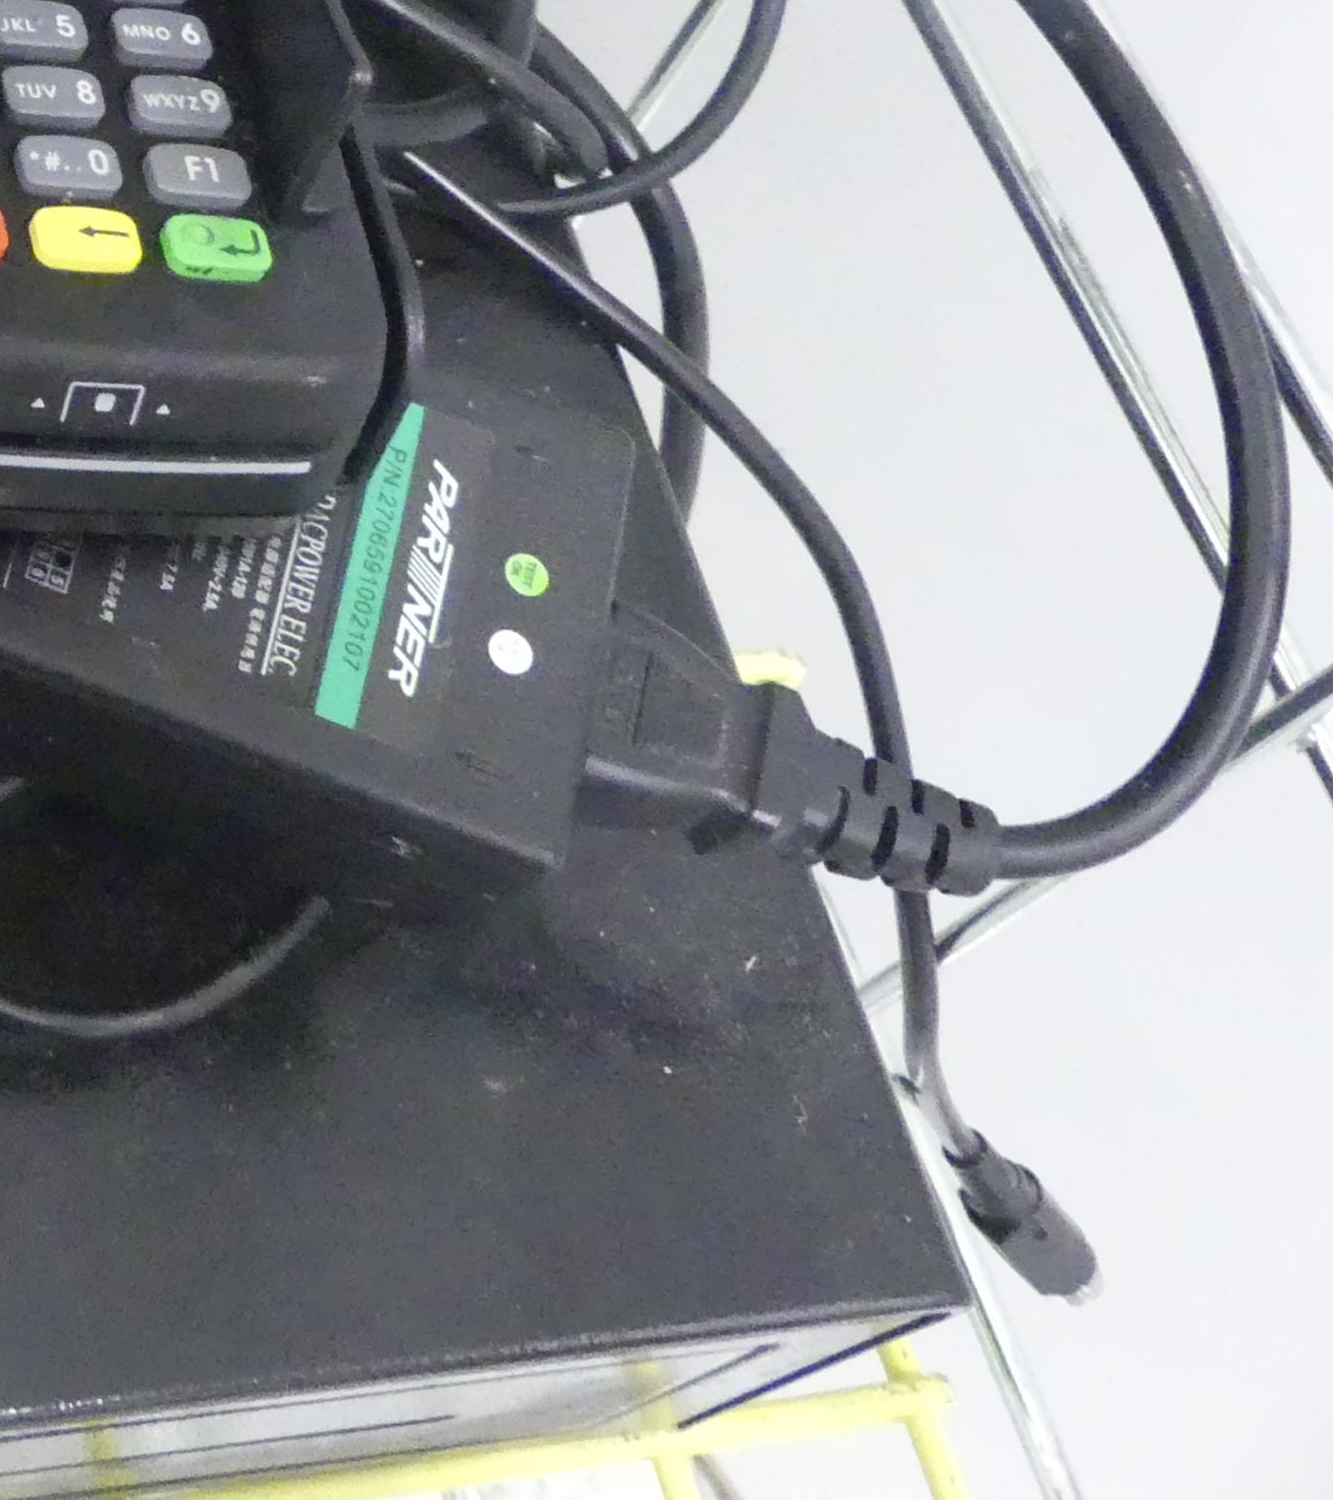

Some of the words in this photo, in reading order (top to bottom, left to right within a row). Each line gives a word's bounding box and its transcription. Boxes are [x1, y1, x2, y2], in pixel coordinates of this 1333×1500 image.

[0, 16, 35, 33] JKL
[56, 14, 76, 38] 5
[122, 25, 171, 41] MNO
[181, 21, 201, 46] 6
[14, 82, 56, 100] TUV
[76, 80, 96, 105] 8
[143, 92, 200, 112] WXYZ
[200, 88, 221, 114] 9
[88, 148, 110, 176] 0
[184, 154, 220, 183] F1
[387, 458, 461, 697] PARTNER
[266, 614, 307, 680] ELEC.
